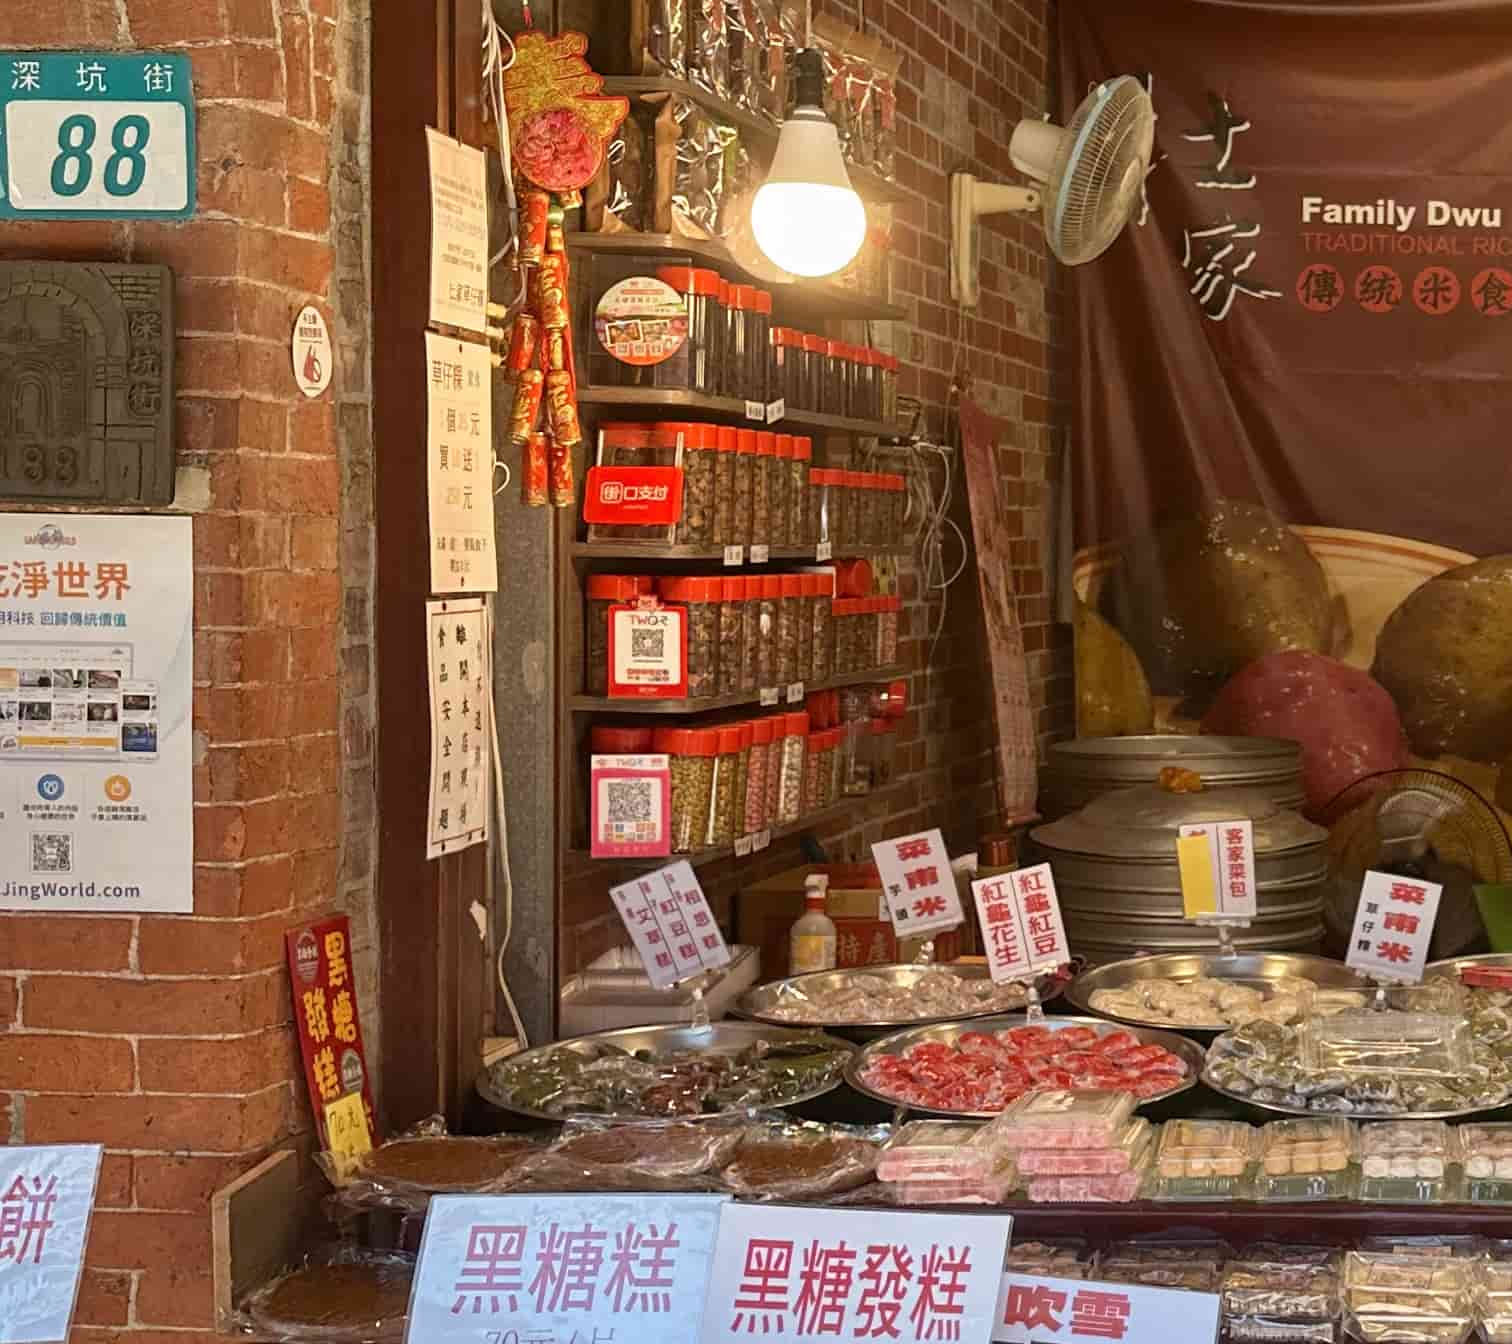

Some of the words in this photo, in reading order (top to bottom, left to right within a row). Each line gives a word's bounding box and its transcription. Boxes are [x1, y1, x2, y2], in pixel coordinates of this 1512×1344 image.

[10, 61, 175, 93] 深坑街
[49, 113, 151, 198] 88
[1302, 197, 1416, 231] Family
[1427, 200, 1502, 228] Dwu
[1302, 232, 1464, 256] TRADITIONAL
[2, 882, 141, 900] JingWorld.com
[450, 1222, 681, 1315] 黑糖糕
[730, 1238, 973, 1342] 黑糖發糕
[1003, 1284, 1131, 1340] 吹雪
